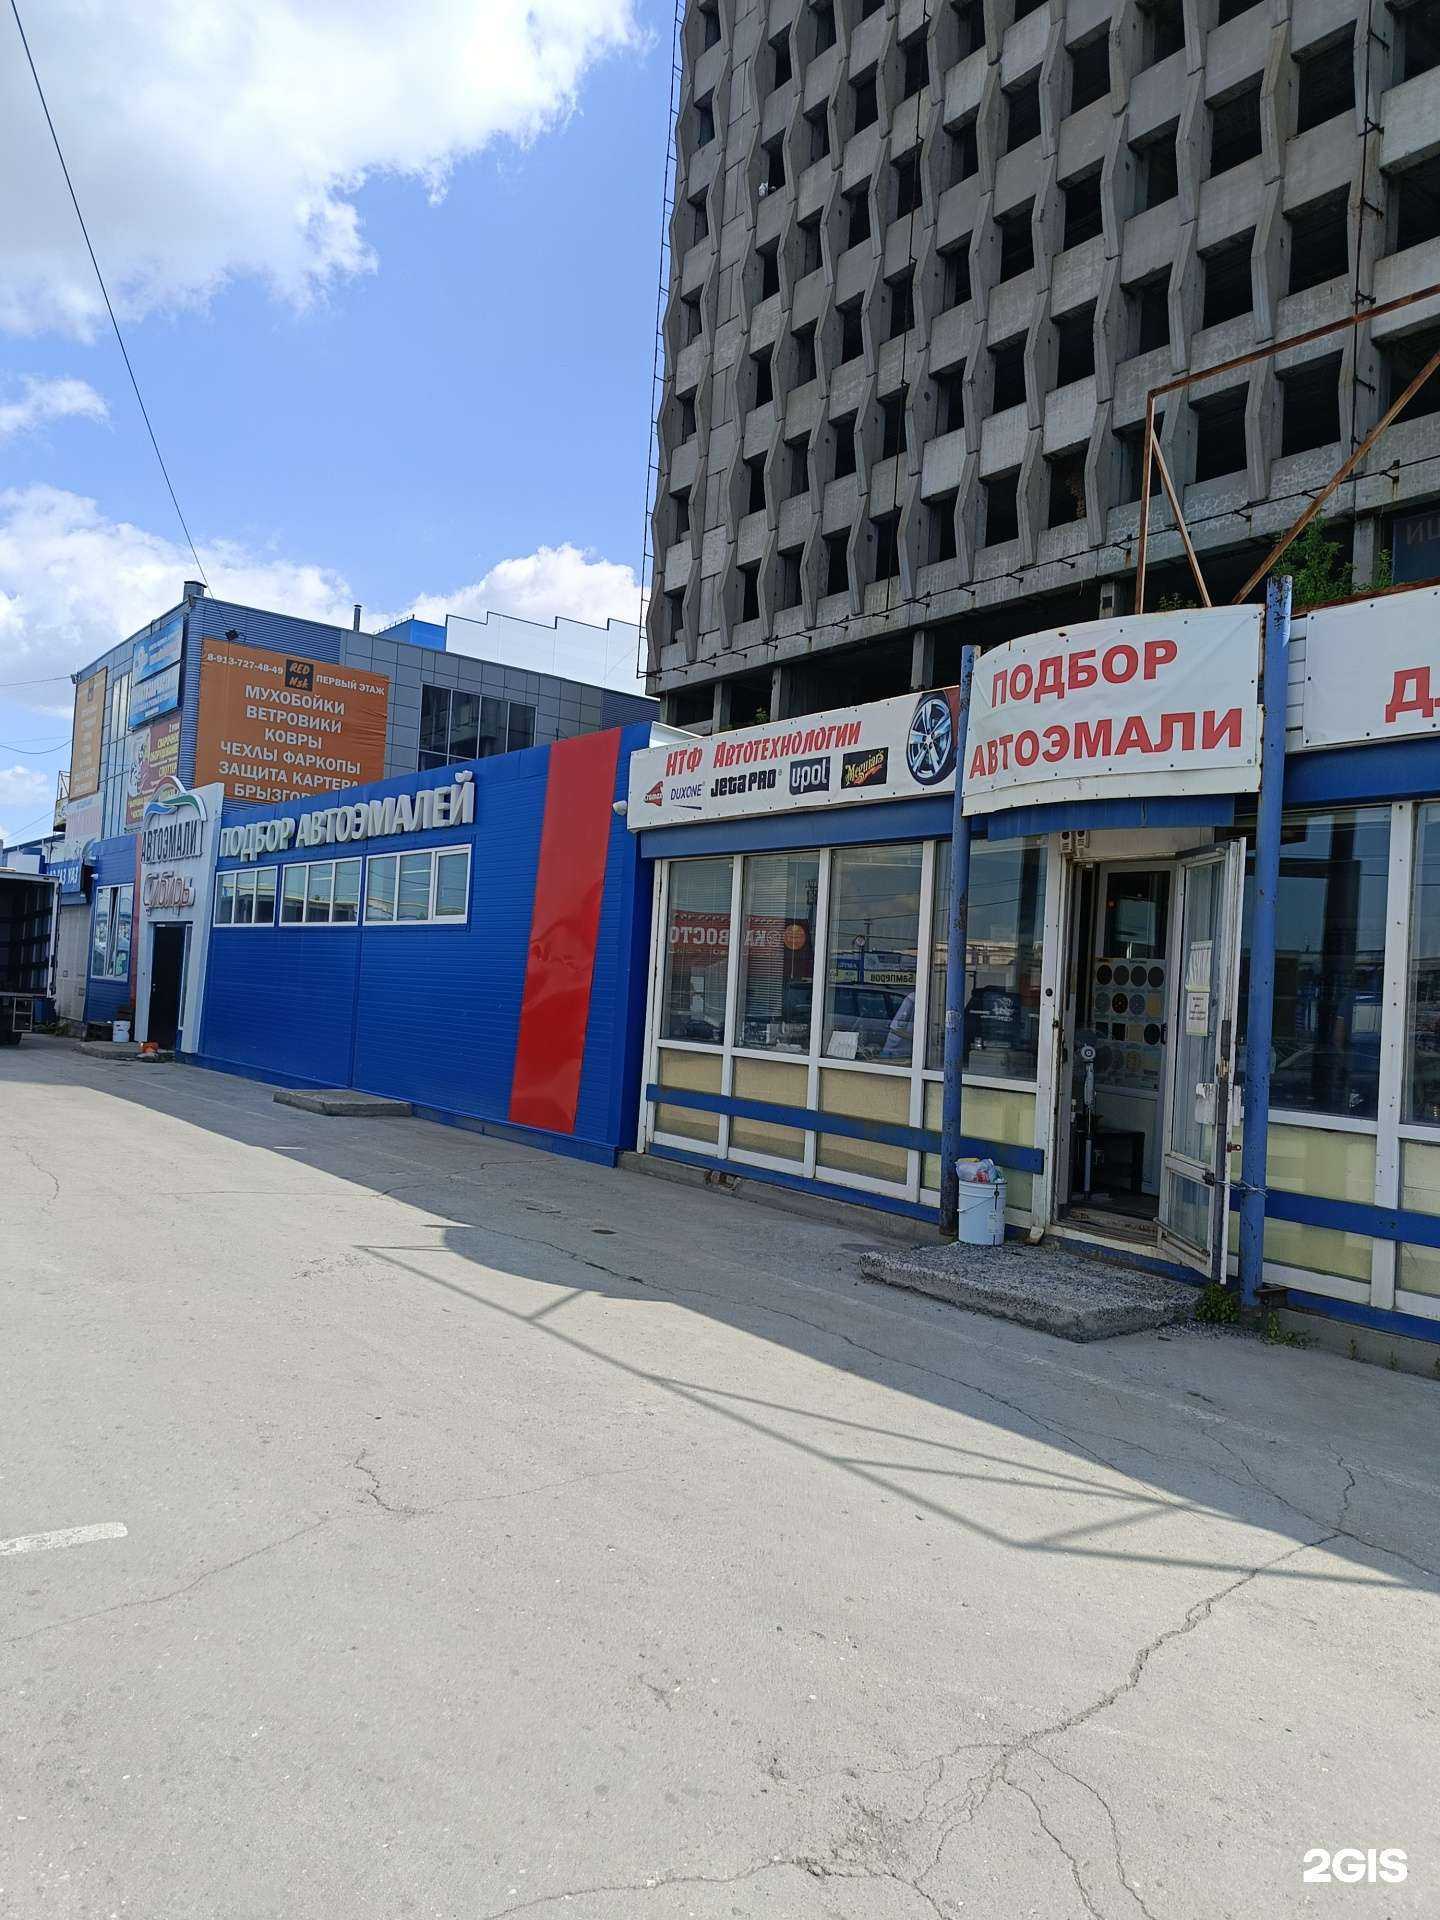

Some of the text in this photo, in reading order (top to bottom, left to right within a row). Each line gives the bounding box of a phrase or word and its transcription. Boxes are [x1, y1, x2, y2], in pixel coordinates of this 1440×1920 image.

[207, 653, 284, 675] 8-913-727-48-49
[991, 639, 1178, 709] ПОДБОР
[245, 685, 345, 716] МУХОБОЙКИ
[316, 674, 385, 696] ПЕРВЫЙ ЭТАЖ
[1386, 666, 1440, 723] Д
[246, 705, 343, 734] ВЕТРОВИКИ
[264, 727, 323, 750] КОВРЫ
[969, 708, 1243, 780] АВТОЭМАЛИ
[218, 760, 289, 783] ЗАЩИТА
[220, 740, 362, 775] ЧЕХЛЫ ФАРКОПЫ
[665, 746, 703, 777] НТФ
[670, 783, 703, 801] DUXONE
[219, 770, 475, 862] ПОДБОР АВТОЭМАЛЕЙ
[141, 820, 199, 863] АВТОЭМАЛИ
